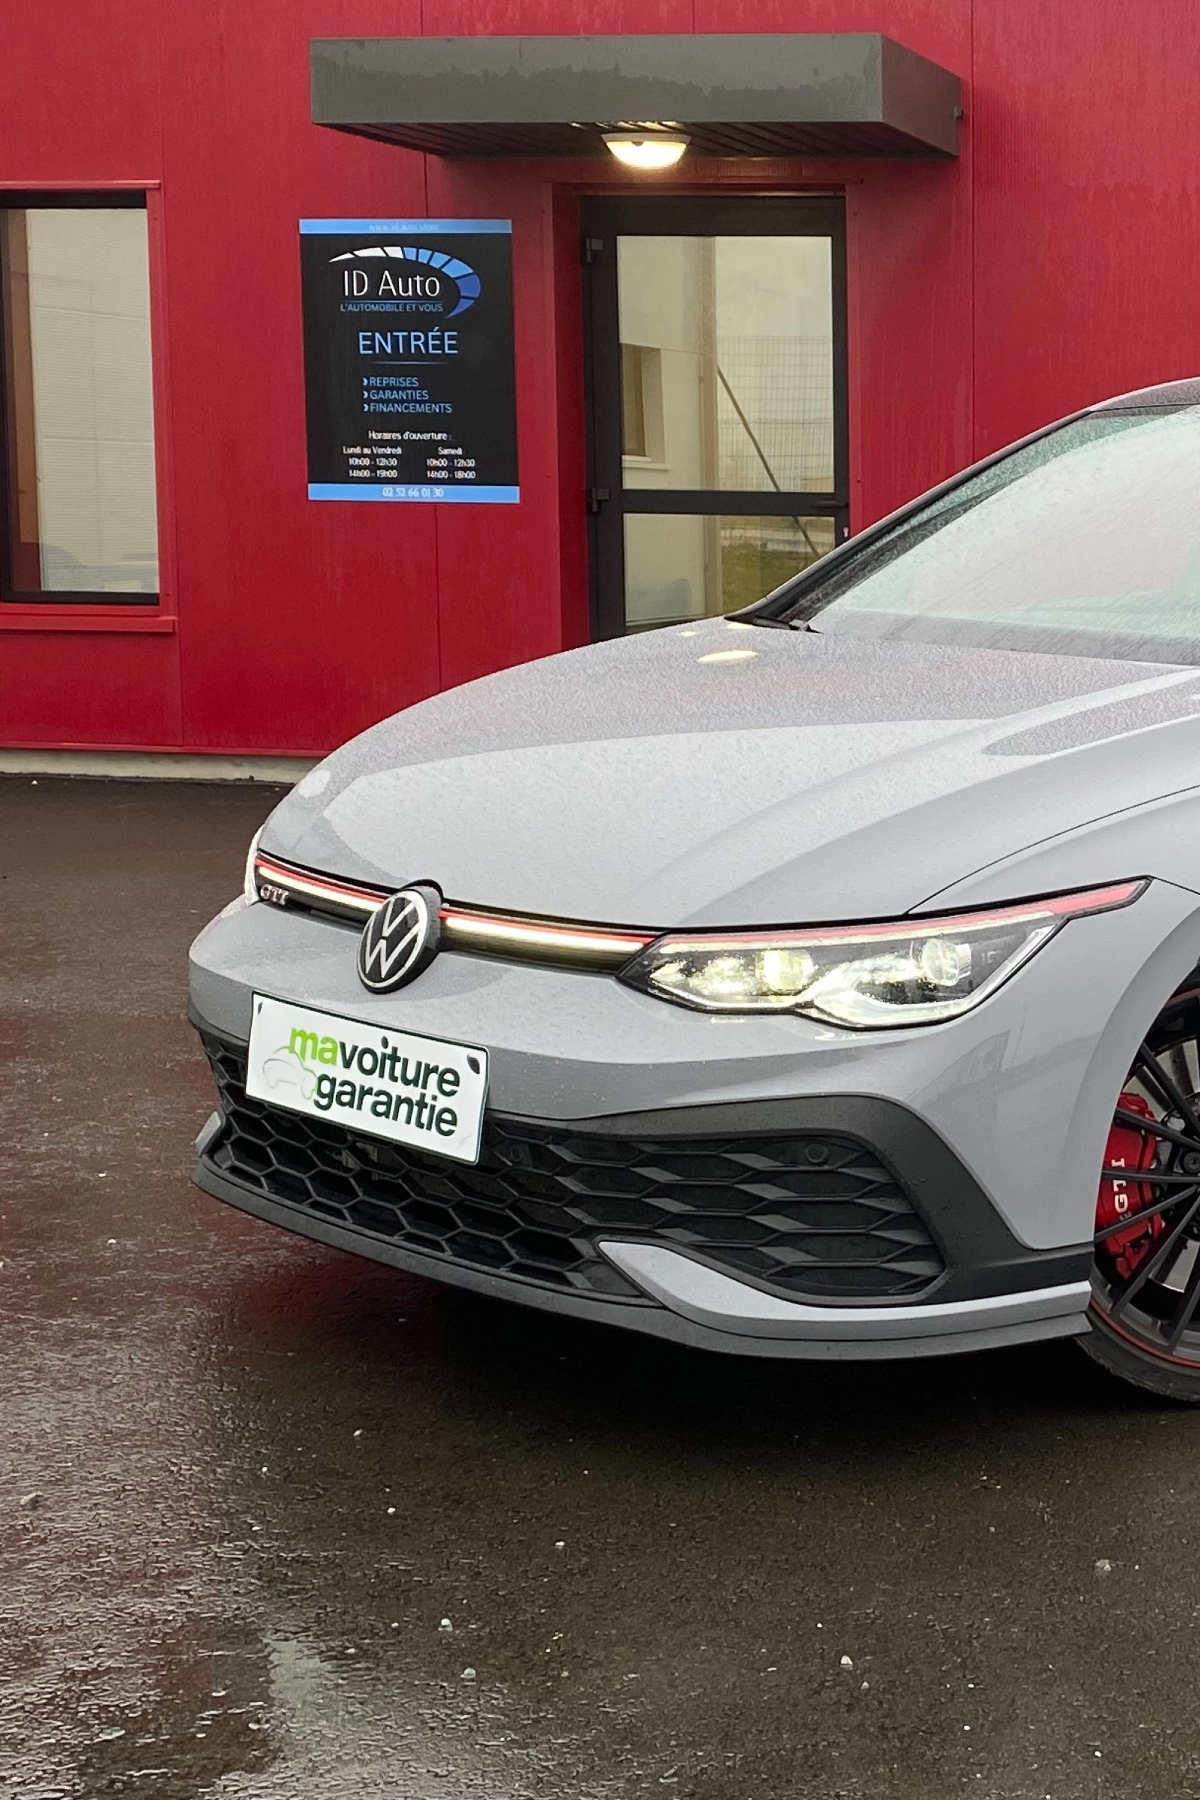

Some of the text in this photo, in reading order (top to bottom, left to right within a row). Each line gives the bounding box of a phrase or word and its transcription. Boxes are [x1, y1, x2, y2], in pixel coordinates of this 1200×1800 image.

[343, 269, 441, 298] ID Auto
[340, 302, 444, 312] L'AUTOMOBILE ET VOUS
[358, 326, 459, 355] ENTRÉE
[369, 377, 419, 387] REPRISES
[369, 390, 430, 400] GARANTIES
[369, 402, 453, 414] FINANCEMENTS
[368, 430, 402, 440] Horaires
[342, 445, 402, 455] Lundi au Vendredi
[438, 446, 463, 455] Samedi
[259, 883, 290, 907] GTI
[313, 1073, 459, 1137] garantie
